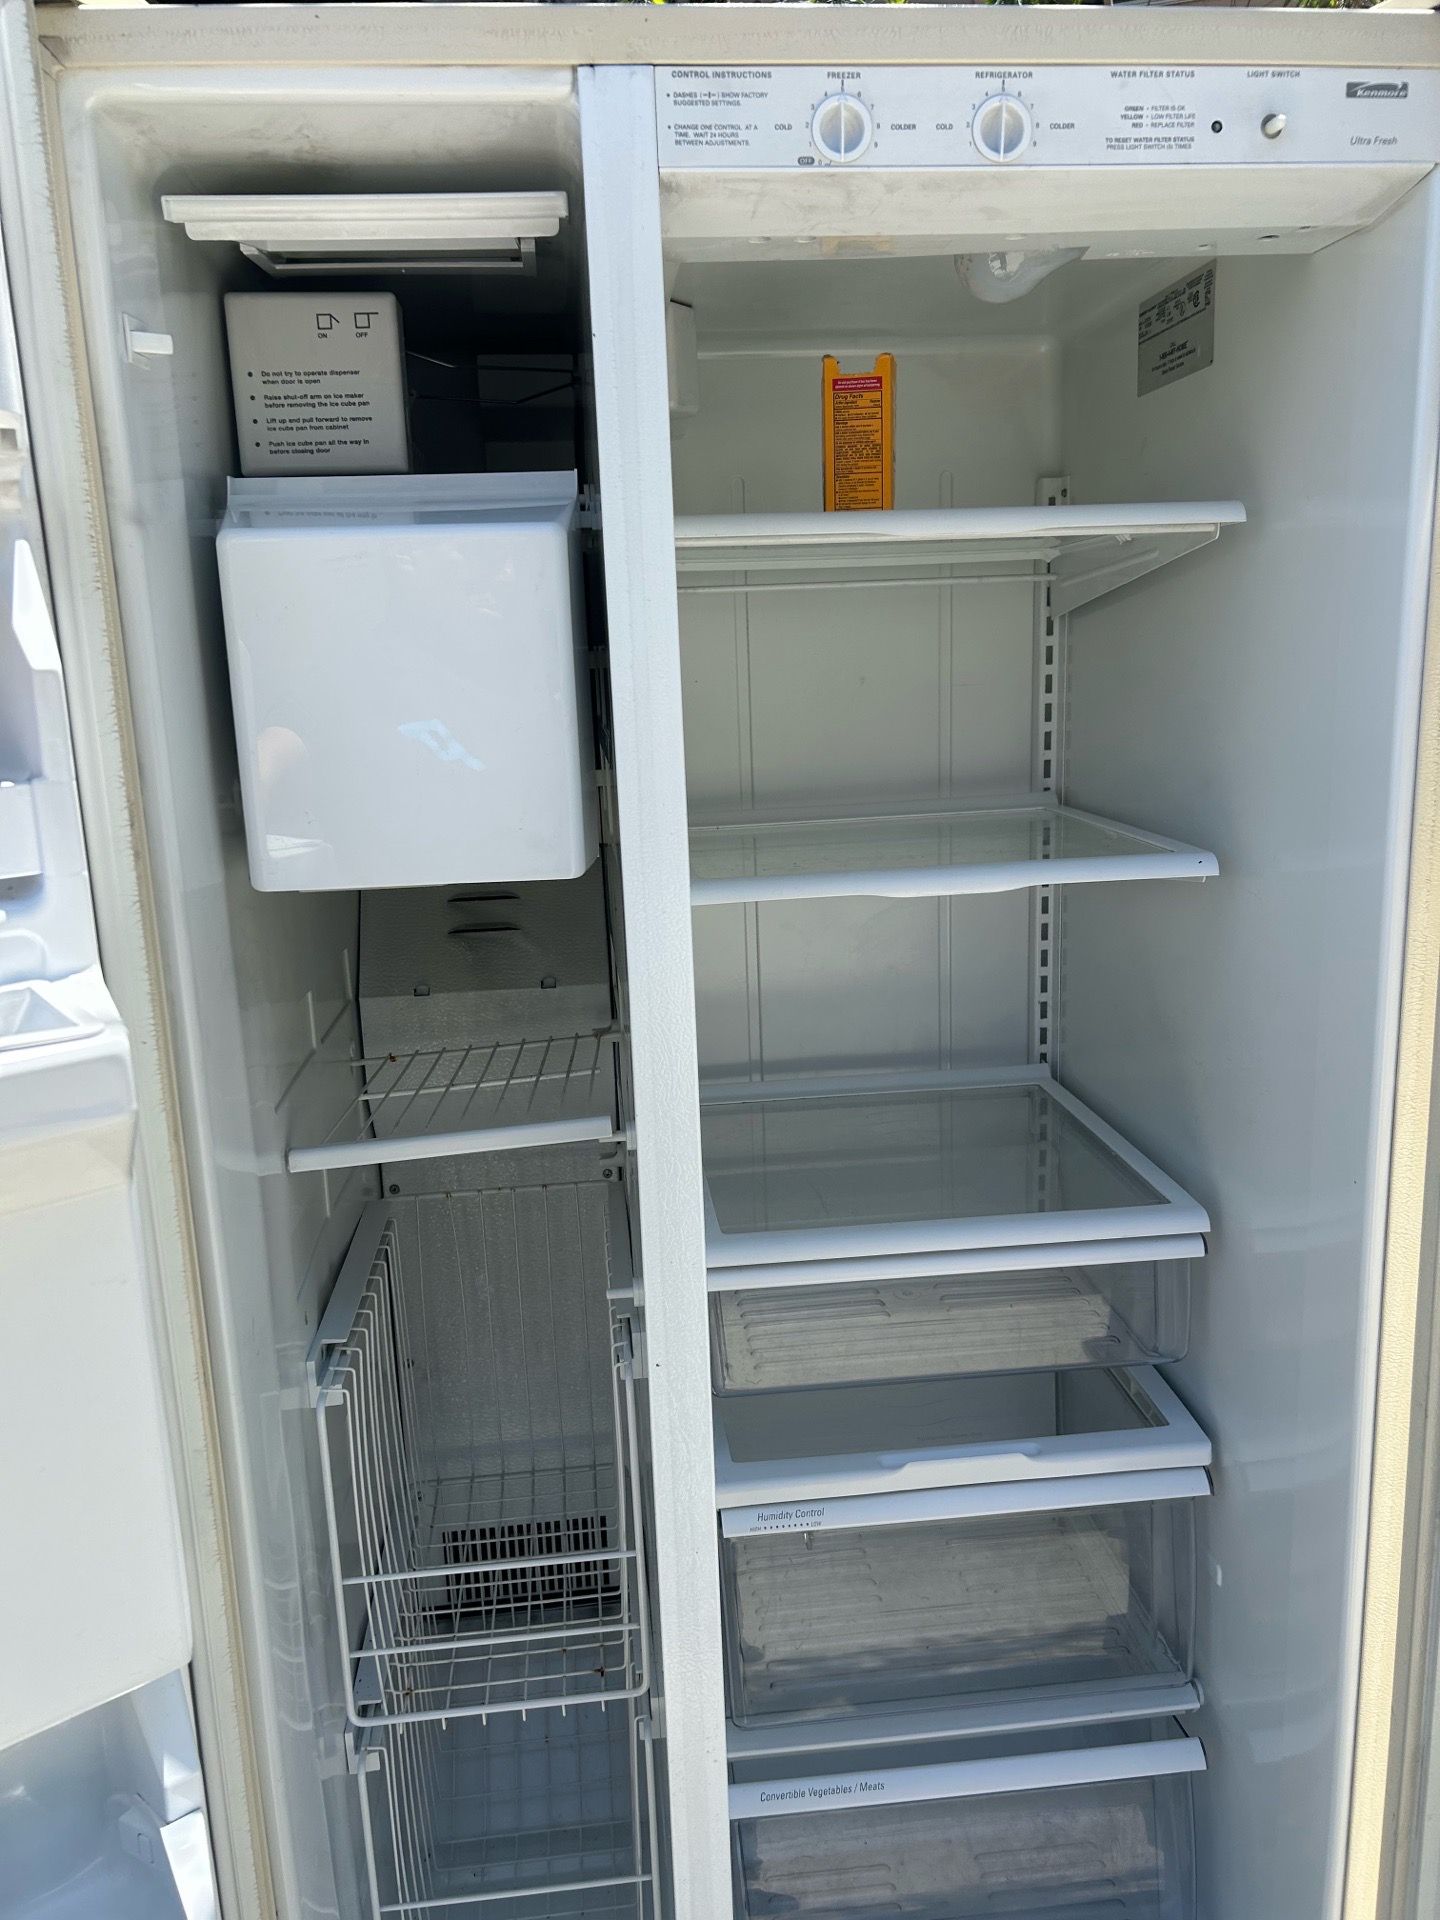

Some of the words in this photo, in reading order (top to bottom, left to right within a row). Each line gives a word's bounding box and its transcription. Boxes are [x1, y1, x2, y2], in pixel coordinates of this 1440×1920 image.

[671, 70, 710, 79] CONTROL
[712, 70, 772, 79] INSTRUCTIONS
[827, 71, 861, 80] FREEZER
[975, 71, 1033, 79] REFRIGERATOR
[1110, 70, 1137, 78] WATER
[1139, 70, 1164, 78] FILTER
[1166, 70, 1195, 78] STATUS
[1247, 70, 1269, 78] LIGHT
[1271, 70, 1300, 78] SWITCH
[1356, 89, 1406, 97] Kenmore
[1350, 136, 1372, 146] Ultra
[1372, 136, 1398, 145] Fresh
[757, 1510, 793, 1522] Humidity
[795, 1508, 825, 1518] Control
[760, 1790, 806, 1802] Convertible
[808, 1784, 852, 1798] Vegetables
[859, 1780, 885, 1792] Meats
